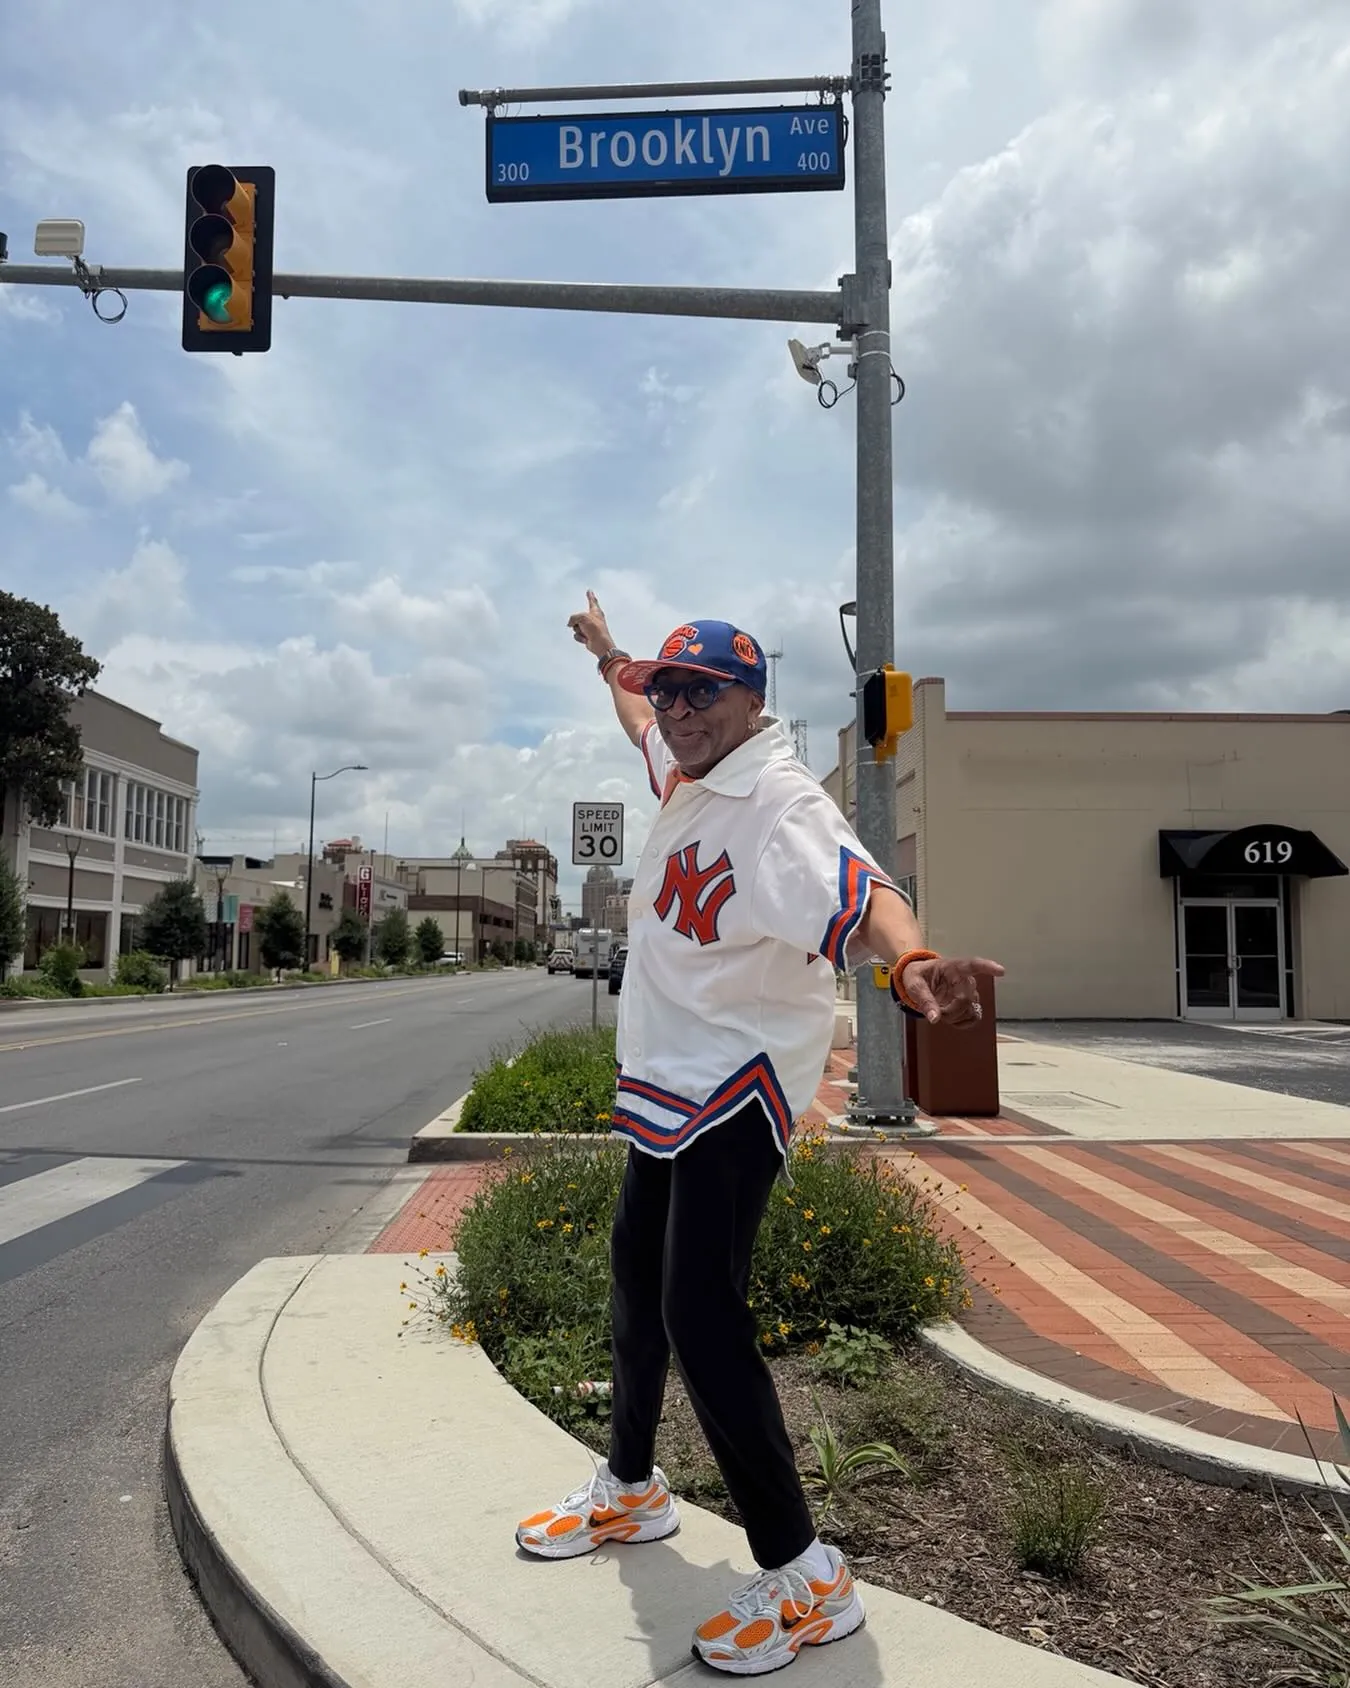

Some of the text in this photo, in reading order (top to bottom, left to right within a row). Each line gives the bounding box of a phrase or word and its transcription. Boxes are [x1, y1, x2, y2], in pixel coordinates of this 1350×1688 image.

[789, 115, 830, 136] Ave
[558, 117, 771, 177] Brooklyn
[497, 162, 530, 182] 300
[797, 152, 831, 172] 400
[577, 809, 620, 820] SPEED
[581, 822, 615, 833] LIMIT
[578, 835, 618, 858] 30
[1244, 841, 1293, 864] 619
[360, 868, 370, 880] G
[653, 840, 736, 946] NY
